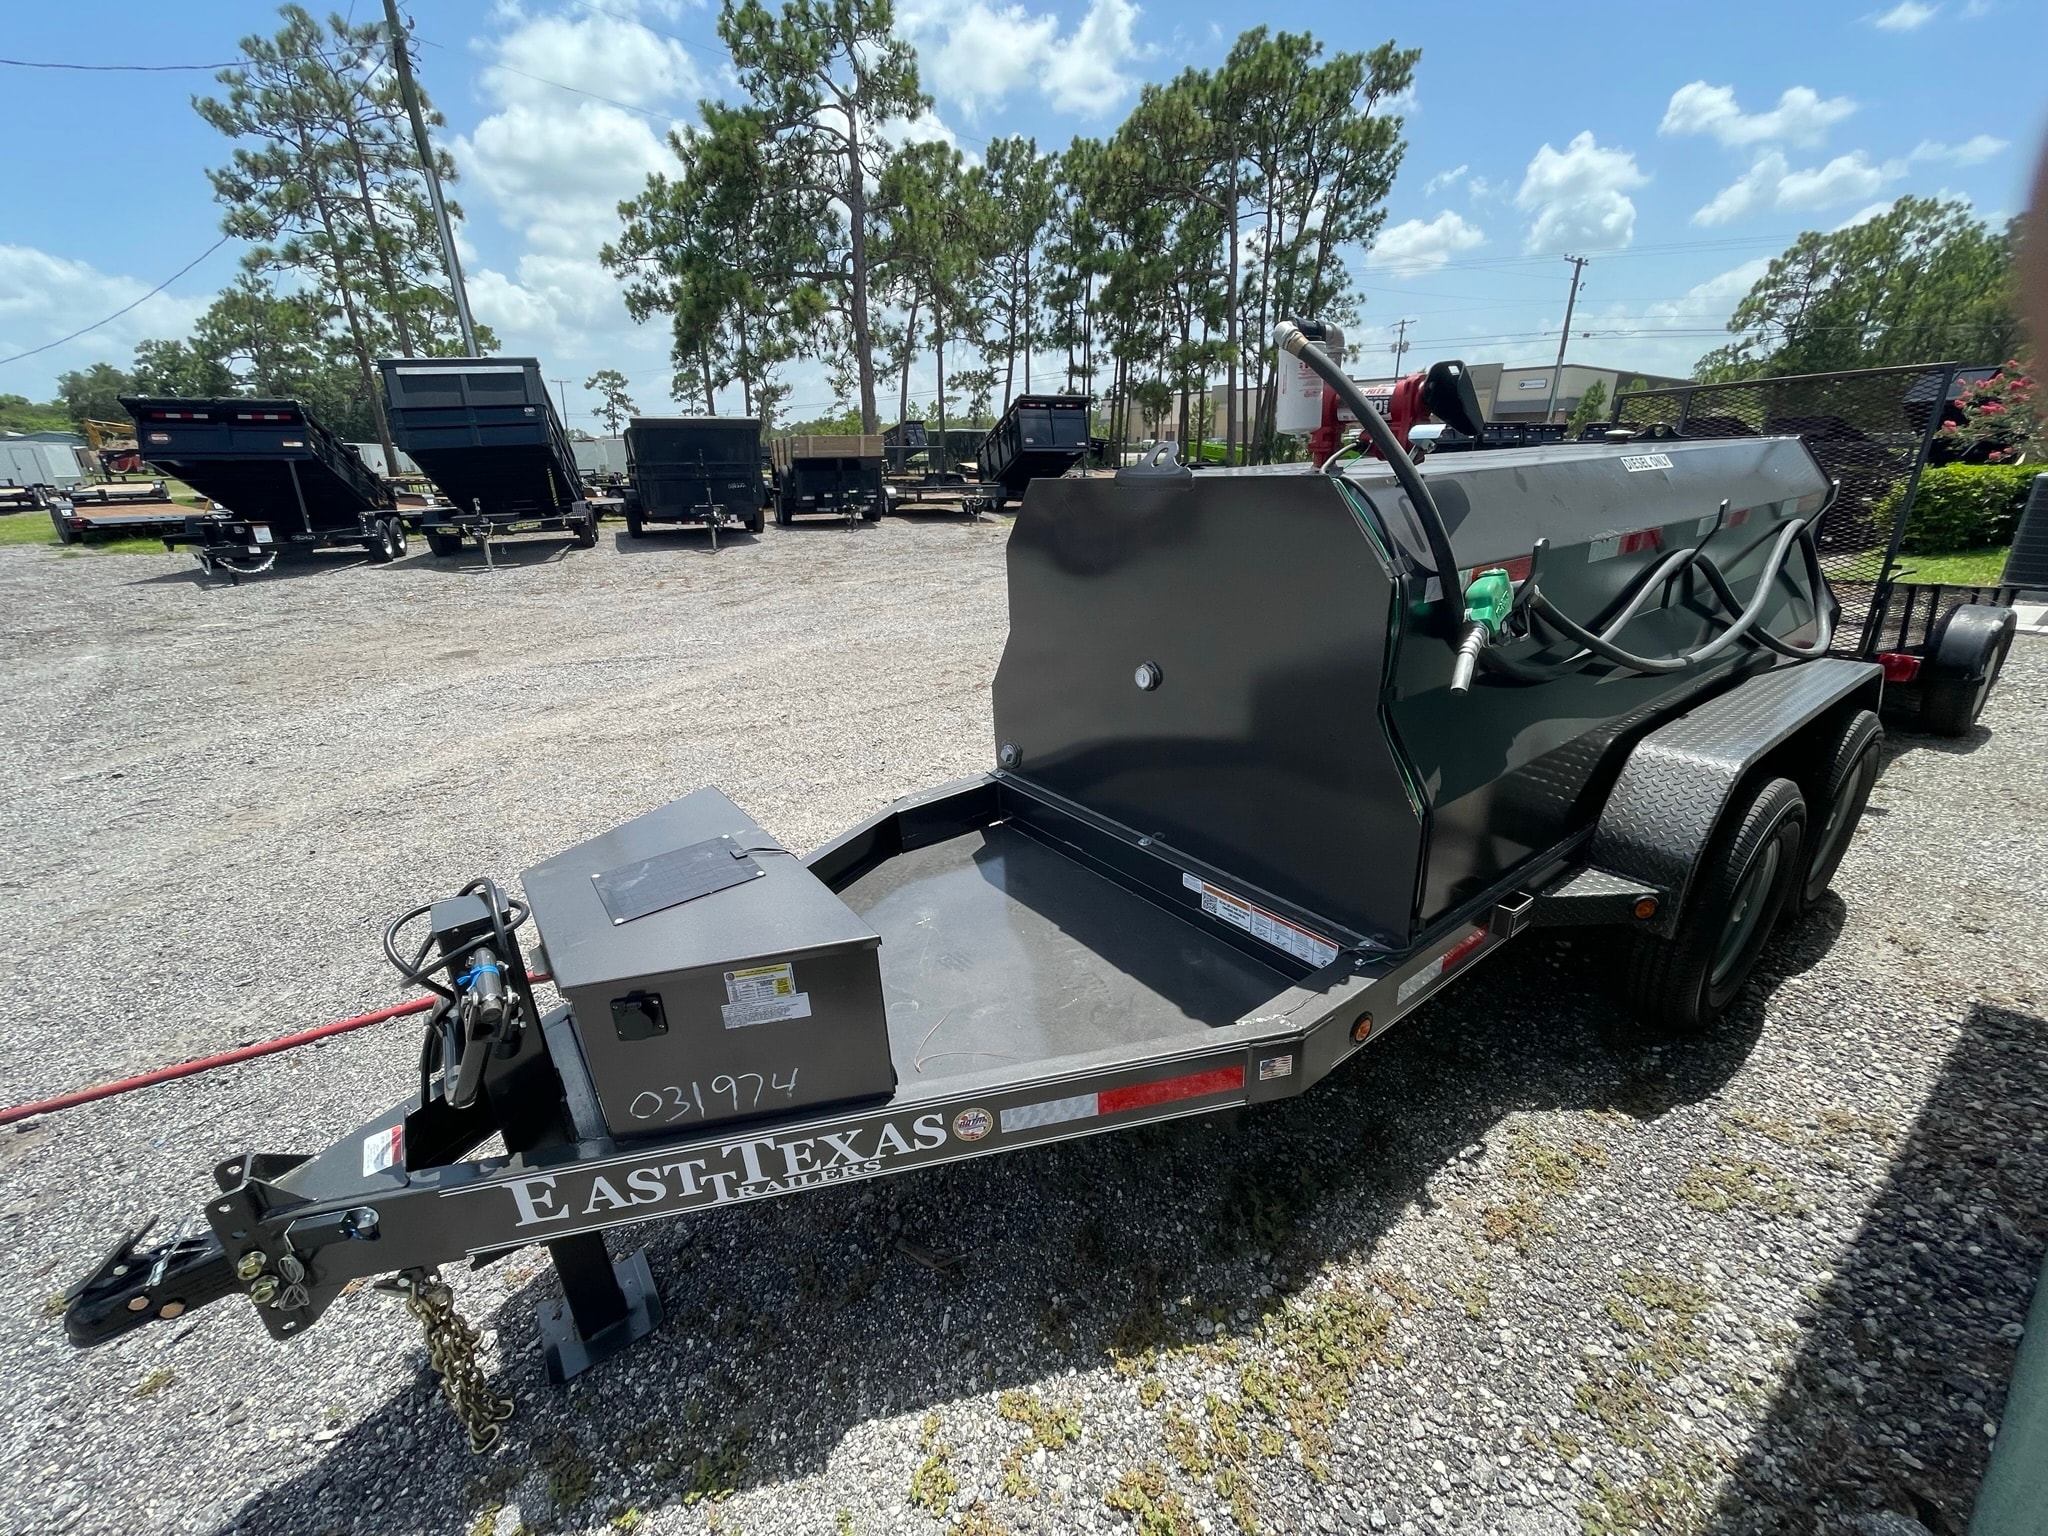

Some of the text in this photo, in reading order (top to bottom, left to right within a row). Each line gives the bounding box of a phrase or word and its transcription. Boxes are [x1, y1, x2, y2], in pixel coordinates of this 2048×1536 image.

[1623, 455, 1670, 469] DIESEL ONLY
[629, 1067, 798, 1122] 031974
[502, 1112, 948, 1227] EAST TEXAS
[700, 1159, 882, 1204] TRAILERS
